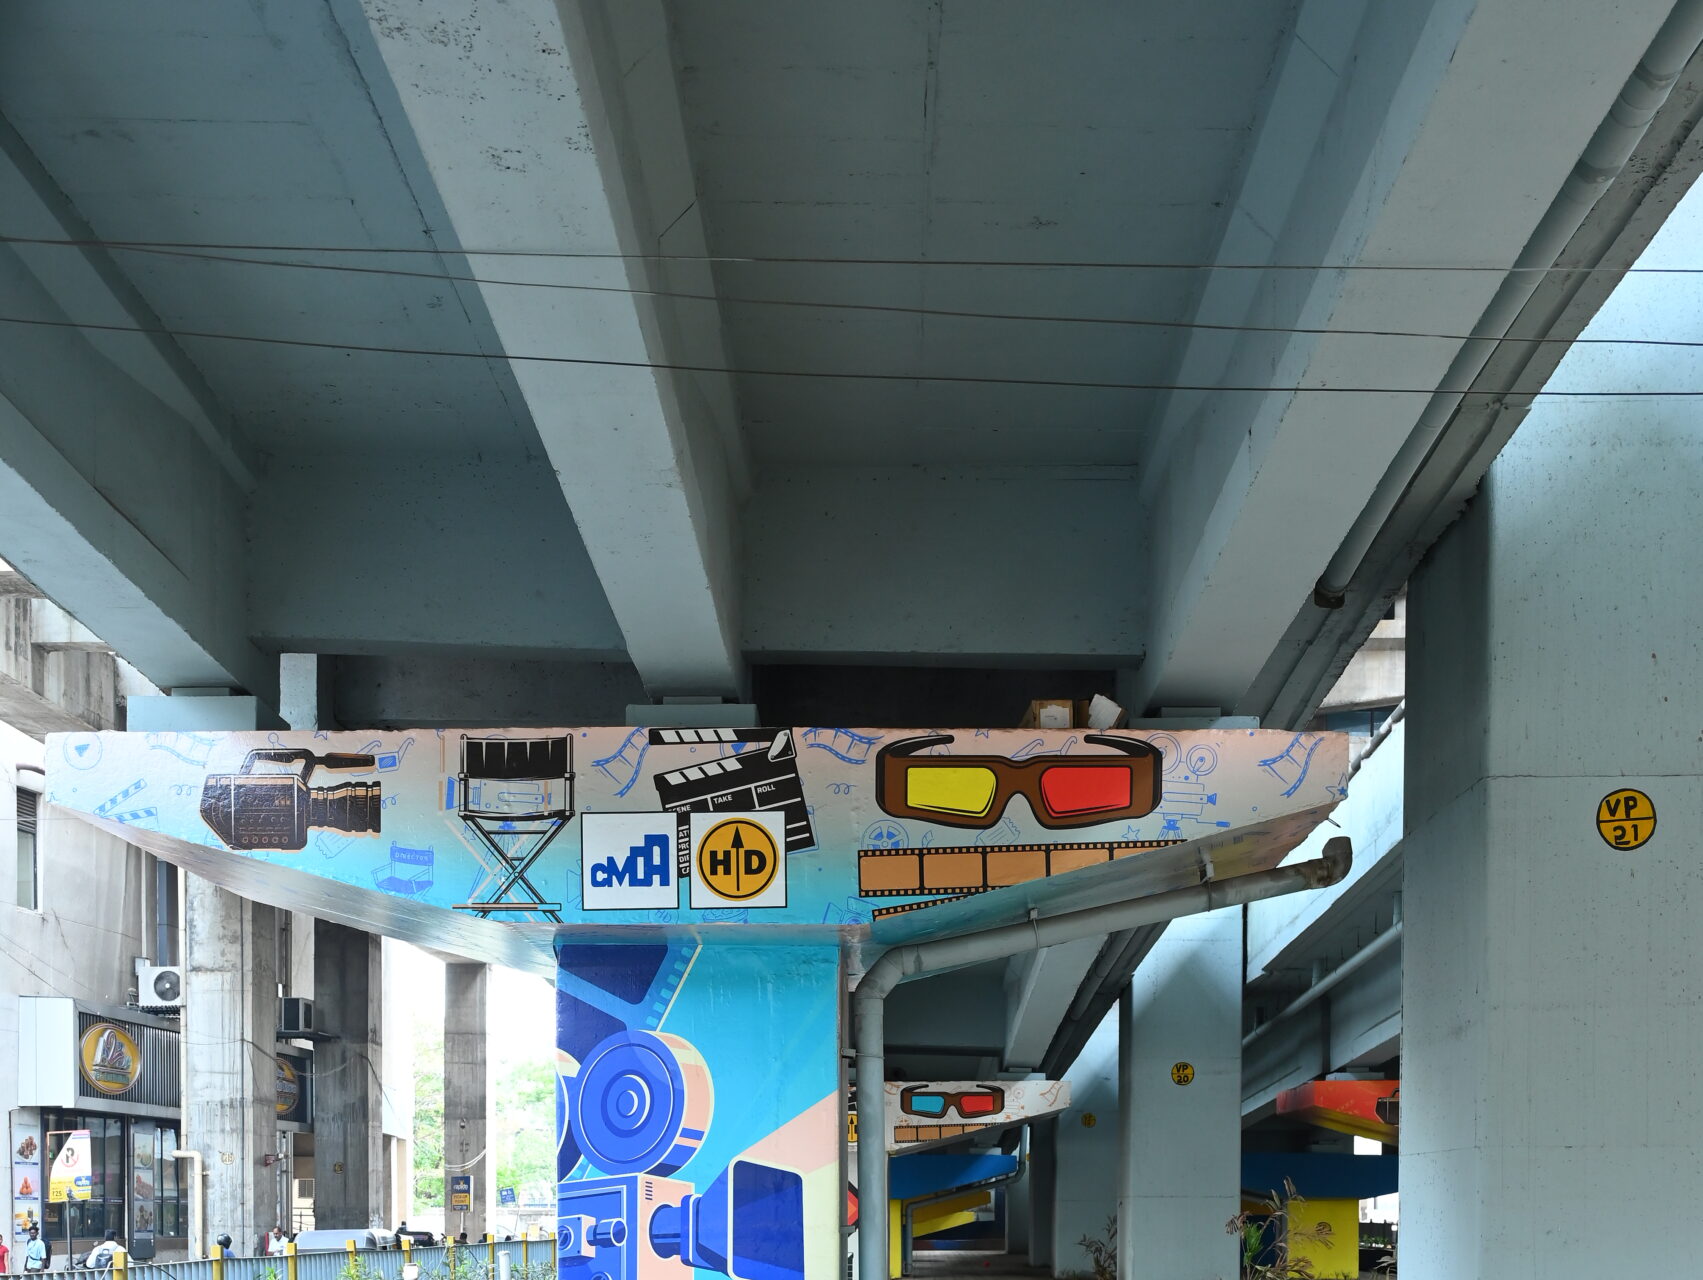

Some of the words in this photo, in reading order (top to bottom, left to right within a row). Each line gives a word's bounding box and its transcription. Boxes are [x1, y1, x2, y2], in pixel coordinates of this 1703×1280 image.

[756, 784, 776, 794] ROLL
[713, 795, 733, 804] TAKE
[1605, 796, 1638, 818] VP
[1612, 824, 1639, 845] 21
[1175, 1064, 1189, 1073] VP
[1176, 1074, 1189, 1084] 20
